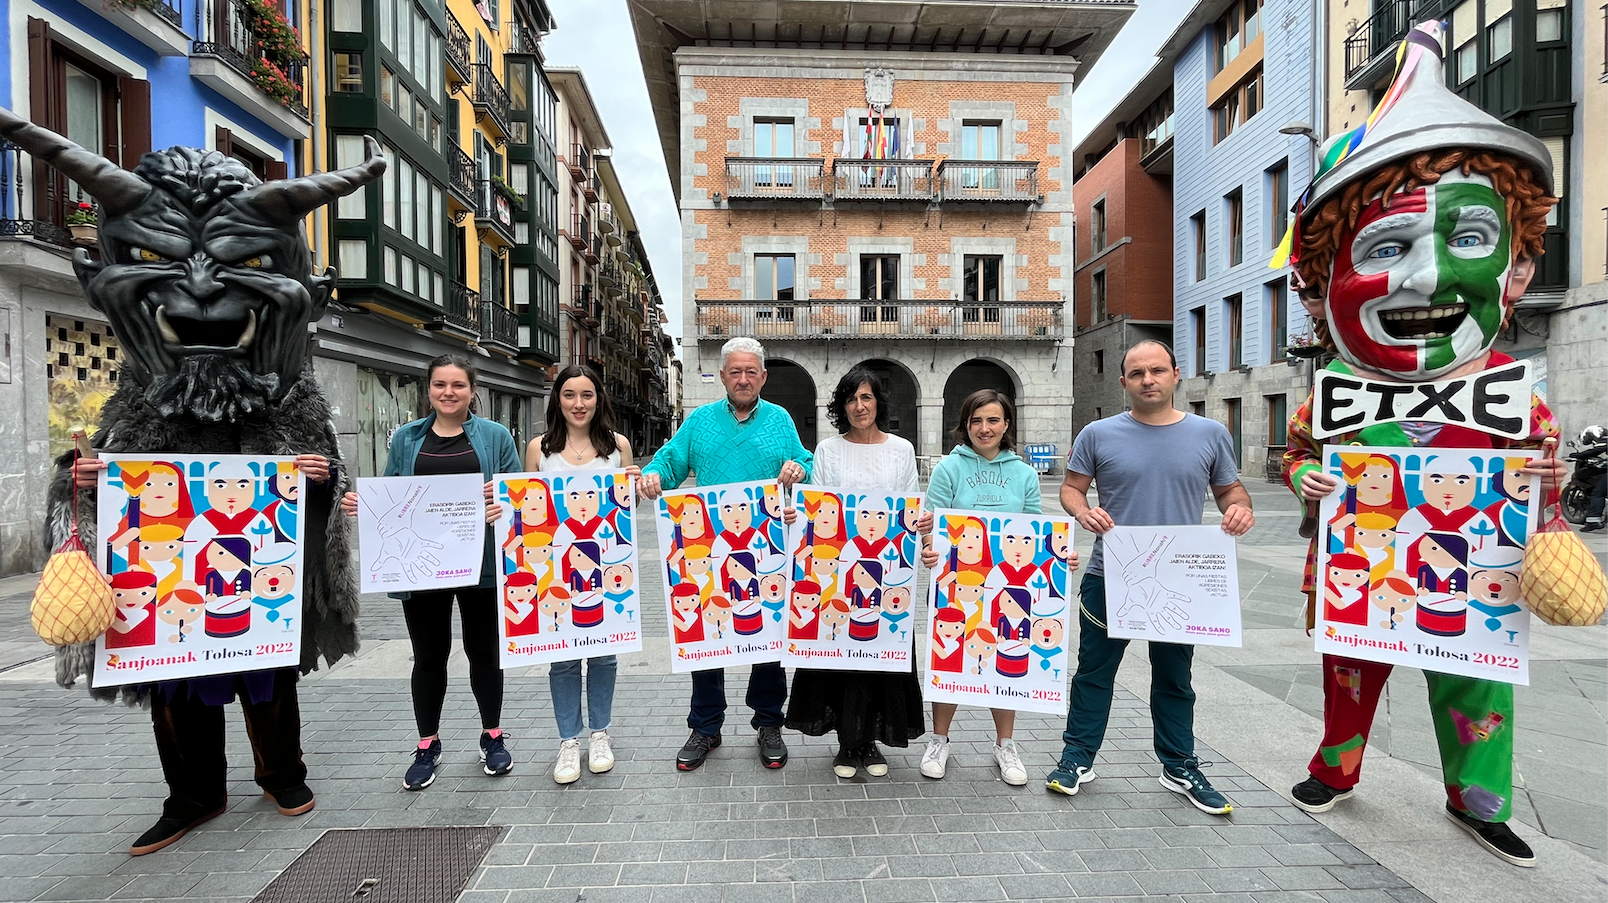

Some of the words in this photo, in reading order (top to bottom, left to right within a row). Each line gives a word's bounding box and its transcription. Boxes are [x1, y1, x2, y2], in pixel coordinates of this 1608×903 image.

[1321, 365, 1526, 432] ETXE
[966, 471, 1011, 489] BASQUE
[507, 640, 569, 655] Sanjoanak
[572, 636, 607, 647] Tolosa
[609, 631, 637, 643] 2022
[678, 645, 732, 661] Sanjoanak
[735, 644, 768, 655] Tolosa
[769, 640, 783, 650] 20
[788, 645, 843, 659] Sanjoanak
[846, 649, 879, 659] Tolosa
[881, 650, 907, 660] 2022
[1324, 627, 1409, 652] Sanjoanak
[1413, 643, 1468, 662] Tolosa
[1472, 651, 1519, 669] 2022
[106, 651, 197, 671] Sanjoanak
[202, 648, 252, 661] Tolosa
[256, 642, 293, 655] 2022
[931, 678, 990, 694] Sanjoanak
[994, 685, 1030, 698] Tolosa
[1032, 689, 1061, 702] 2022
